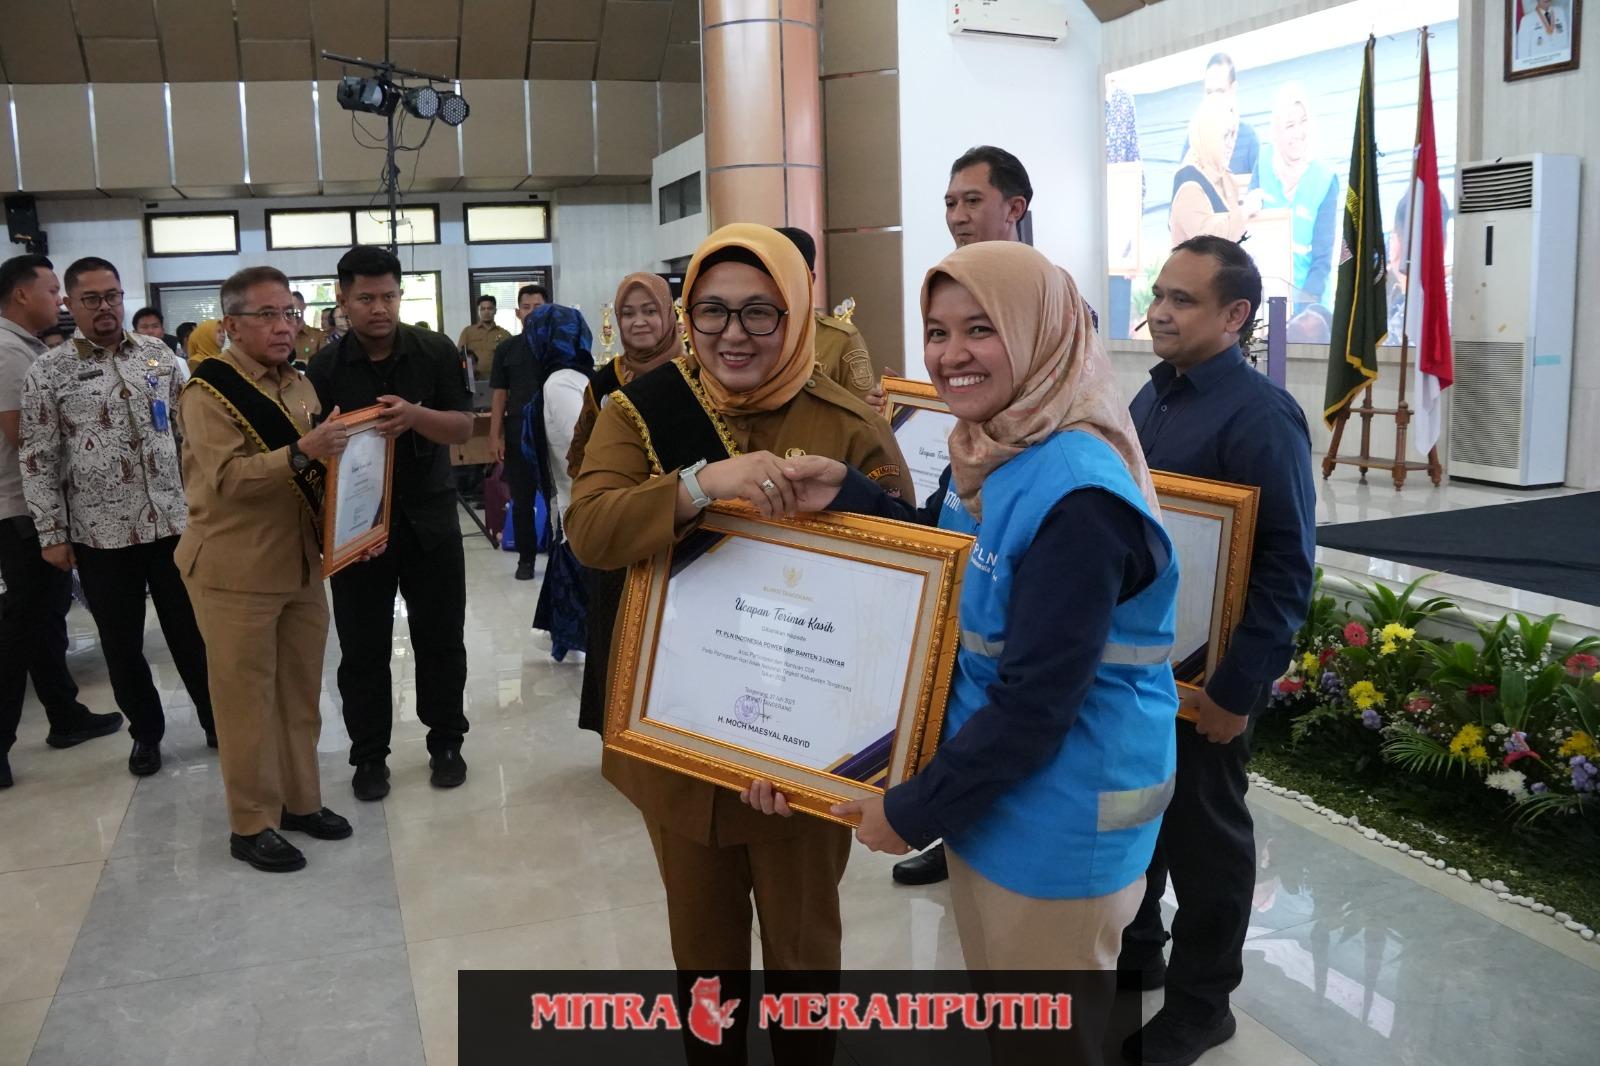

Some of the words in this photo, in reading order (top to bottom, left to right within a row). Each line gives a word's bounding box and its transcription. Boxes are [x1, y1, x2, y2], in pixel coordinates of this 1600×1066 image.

[973, 542, 998, 566] PLN
[735, 597, 769, 619] Ucapan
[774, 607, 805, 626] Terima
[807, 617, 835, 633] Kasih
[735, 633, 763, 647] INDONESIA
[763, 641, 783, 654] POWER
[795, 649, 818, 661] BANTEN
[822, 657, 845, 669] LONTAR
[725, 718, 747, 731] MOCH
[748, 724, 781, 741] MAESYAL
[782, 734, 811, 748] RASYID
